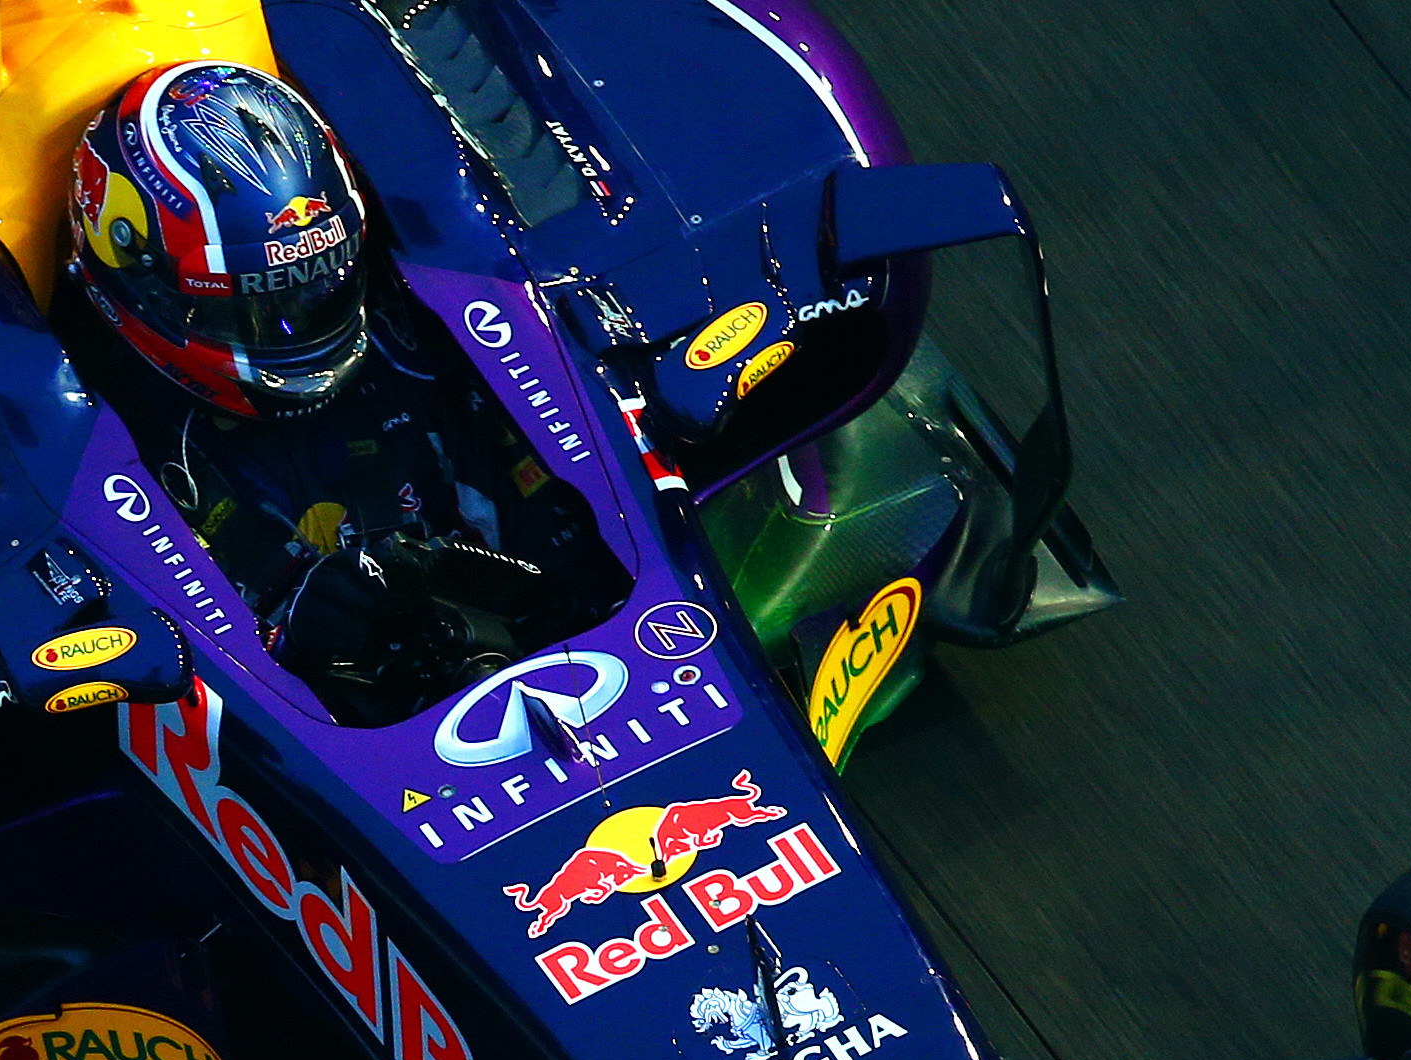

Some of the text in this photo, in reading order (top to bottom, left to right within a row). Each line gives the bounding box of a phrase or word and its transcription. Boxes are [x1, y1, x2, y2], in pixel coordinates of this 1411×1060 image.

[133, 151, 183, 209] INFINITI
[264, 214, 348, 267] Red Bull
[185, 278, 230, 289] TOTAL
[705, 309, 758, 353] RAUCH
[748, 348, 787, 386] RAUCH
[500, 352, 591, 463] INFINITI
[142, 524, 233, 636] INFINITI
[60, 633, 123, 660] RAUCH
[67, 688, 118, 708] RAUCH
[419, 683, 729, 850] INFINITI
[117, 675, 386, 1045] Red
[534, 822, 843, 1006] Red Bull
